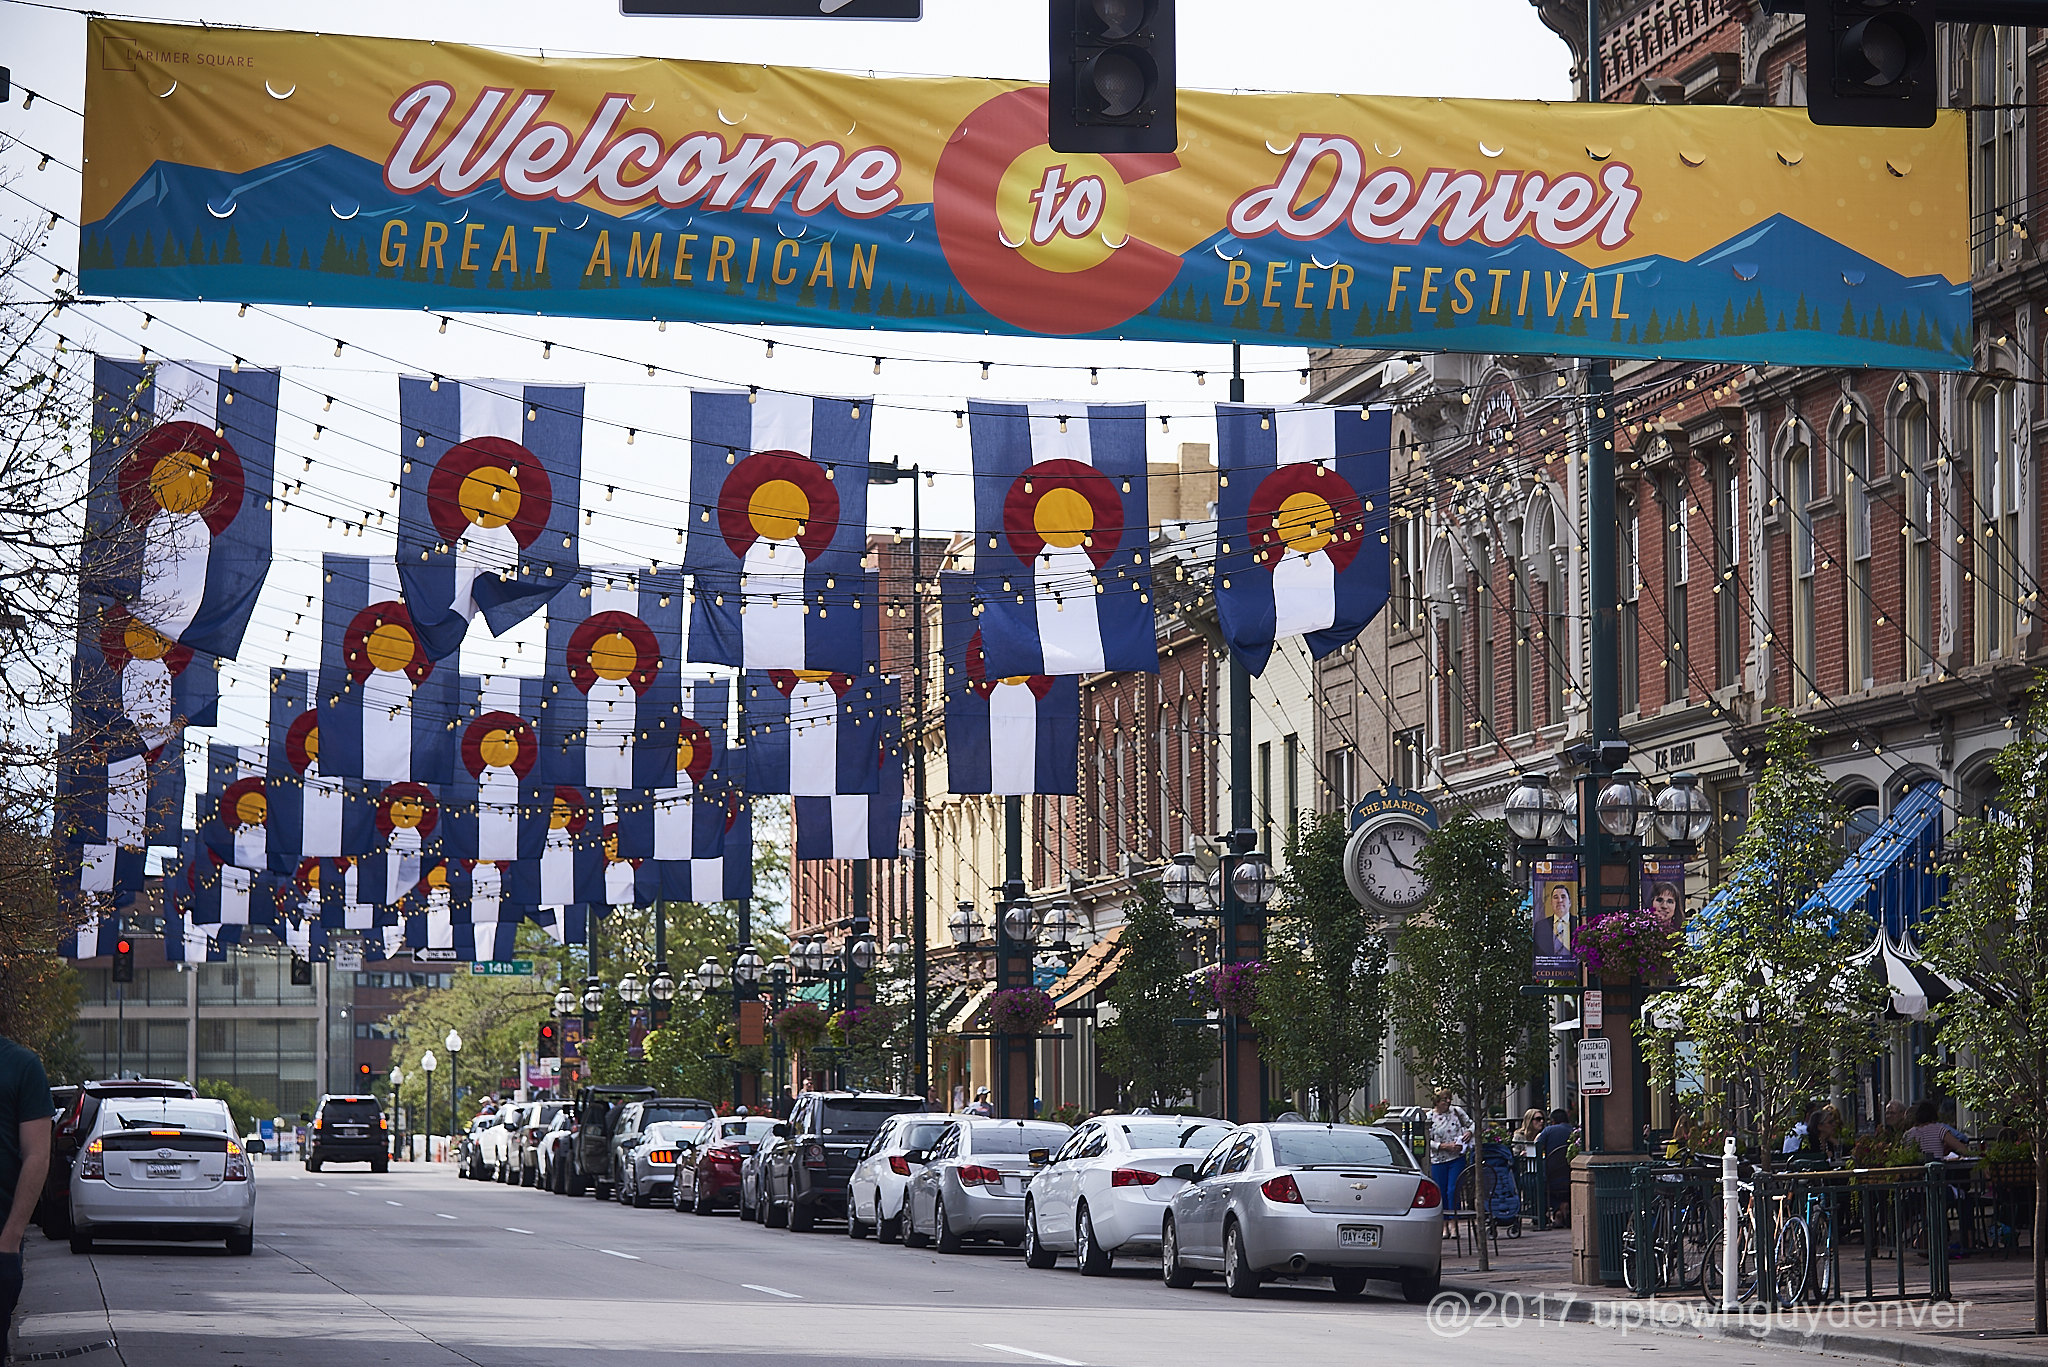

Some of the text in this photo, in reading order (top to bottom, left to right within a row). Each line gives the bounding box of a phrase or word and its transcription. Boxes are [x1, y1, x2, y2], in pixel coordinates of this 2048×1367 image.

[126, 48, 254, 68] LARIMER SQUARE
[384, 81, 1642, 249] Welcome to Denver
[379, 220, 1630, 321] GREAT AMERICAN BEER FESTIVAL
[1359, 799, 1428, 817] THE MARKET
[1392, 830, 1405, 841] 12
[1411, 835, 1416, 846] 1
[1368, 844, 1380, 855] 10
[1363, 859, 1372, 870] 9
[1367, 873, 1376, 885] 8
[1378, 886, 1387, 896] 7
[1393, 889, 1402, 900] 6
[1407, 886, 1417, 897] 5
[489, 962, 513, 973] 14th
[1581, 1042, 1606, 1051] PASSENGER
[1581, 1052, 1607, 1061] LOADING ONLY
[1590, 1061, 1599, 1069] ALL
[1588, 1070, 1602, 1079] TIMES
